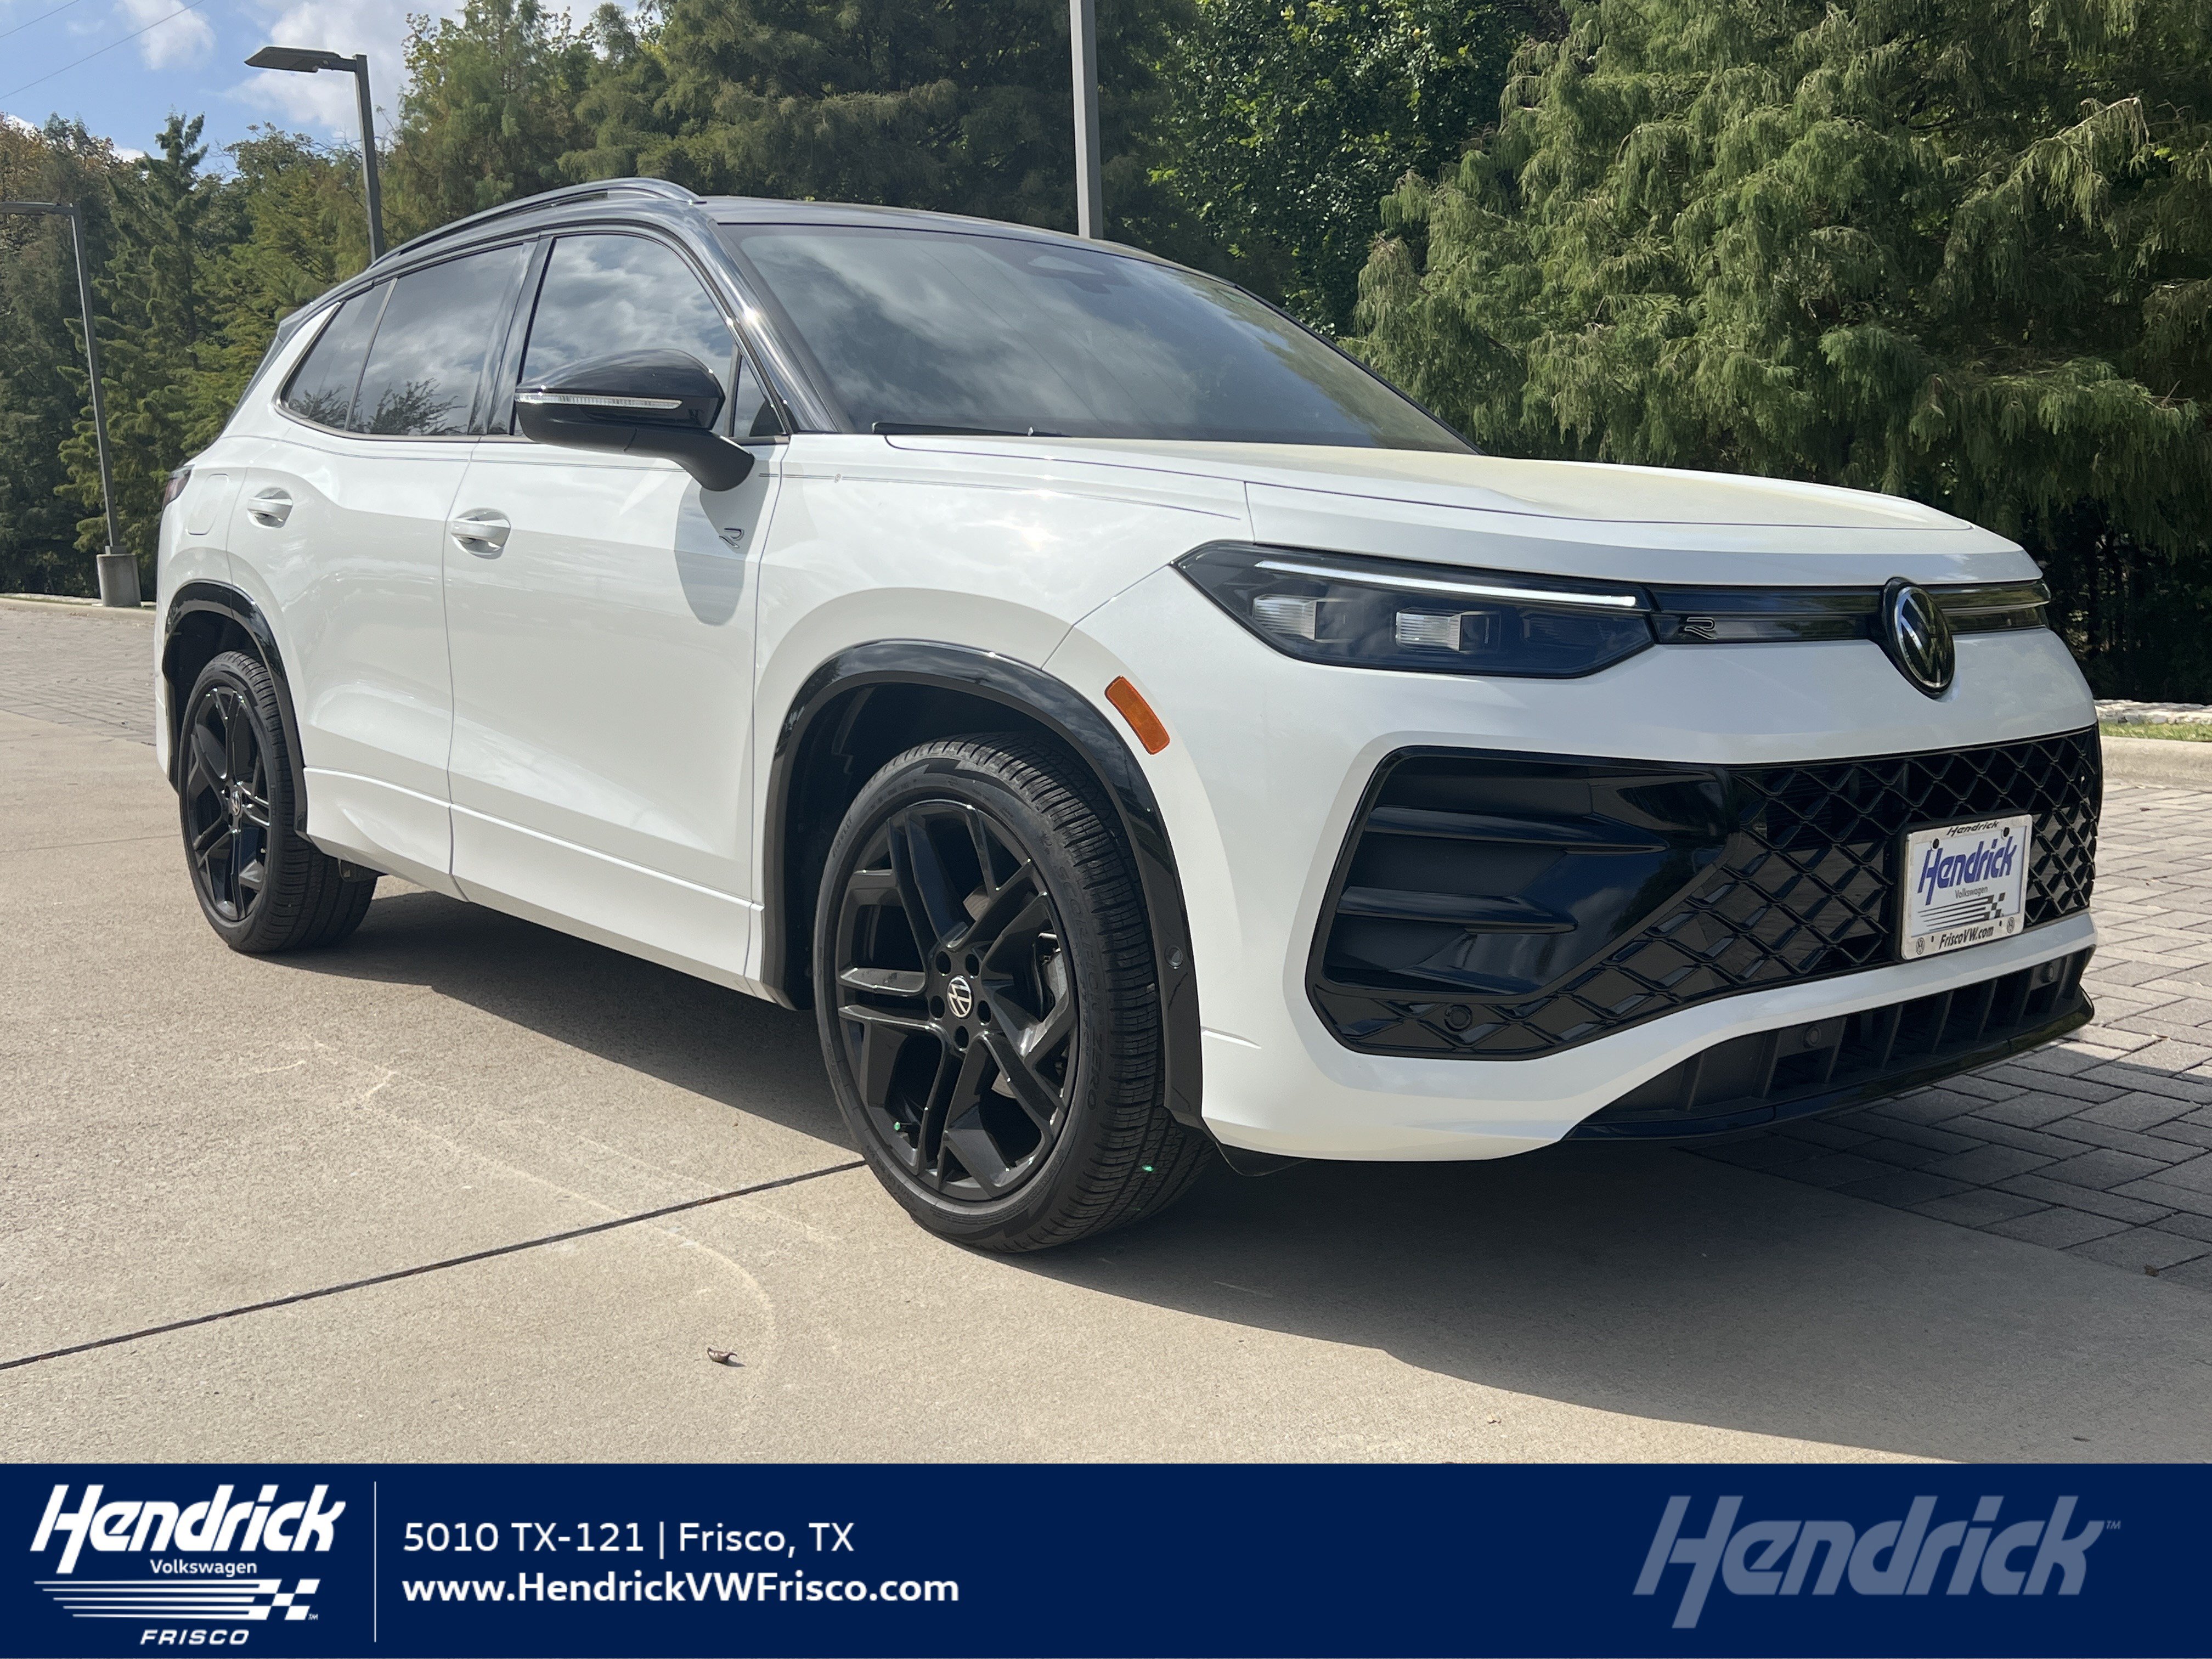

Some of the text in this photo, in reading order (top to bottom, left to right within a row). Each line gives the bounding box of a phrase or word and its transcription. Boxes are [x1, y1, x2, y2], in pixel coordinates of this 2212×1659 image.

[1684, 617, 1718, 640] R
[1946, 821, 1999, 837] Hendrick
[1917, 836, 2017, 905] Hendrick
[1955, 886, 1988, 899] Volkswagen
[1939, 926, 1994, 950] FriscoVW.com
